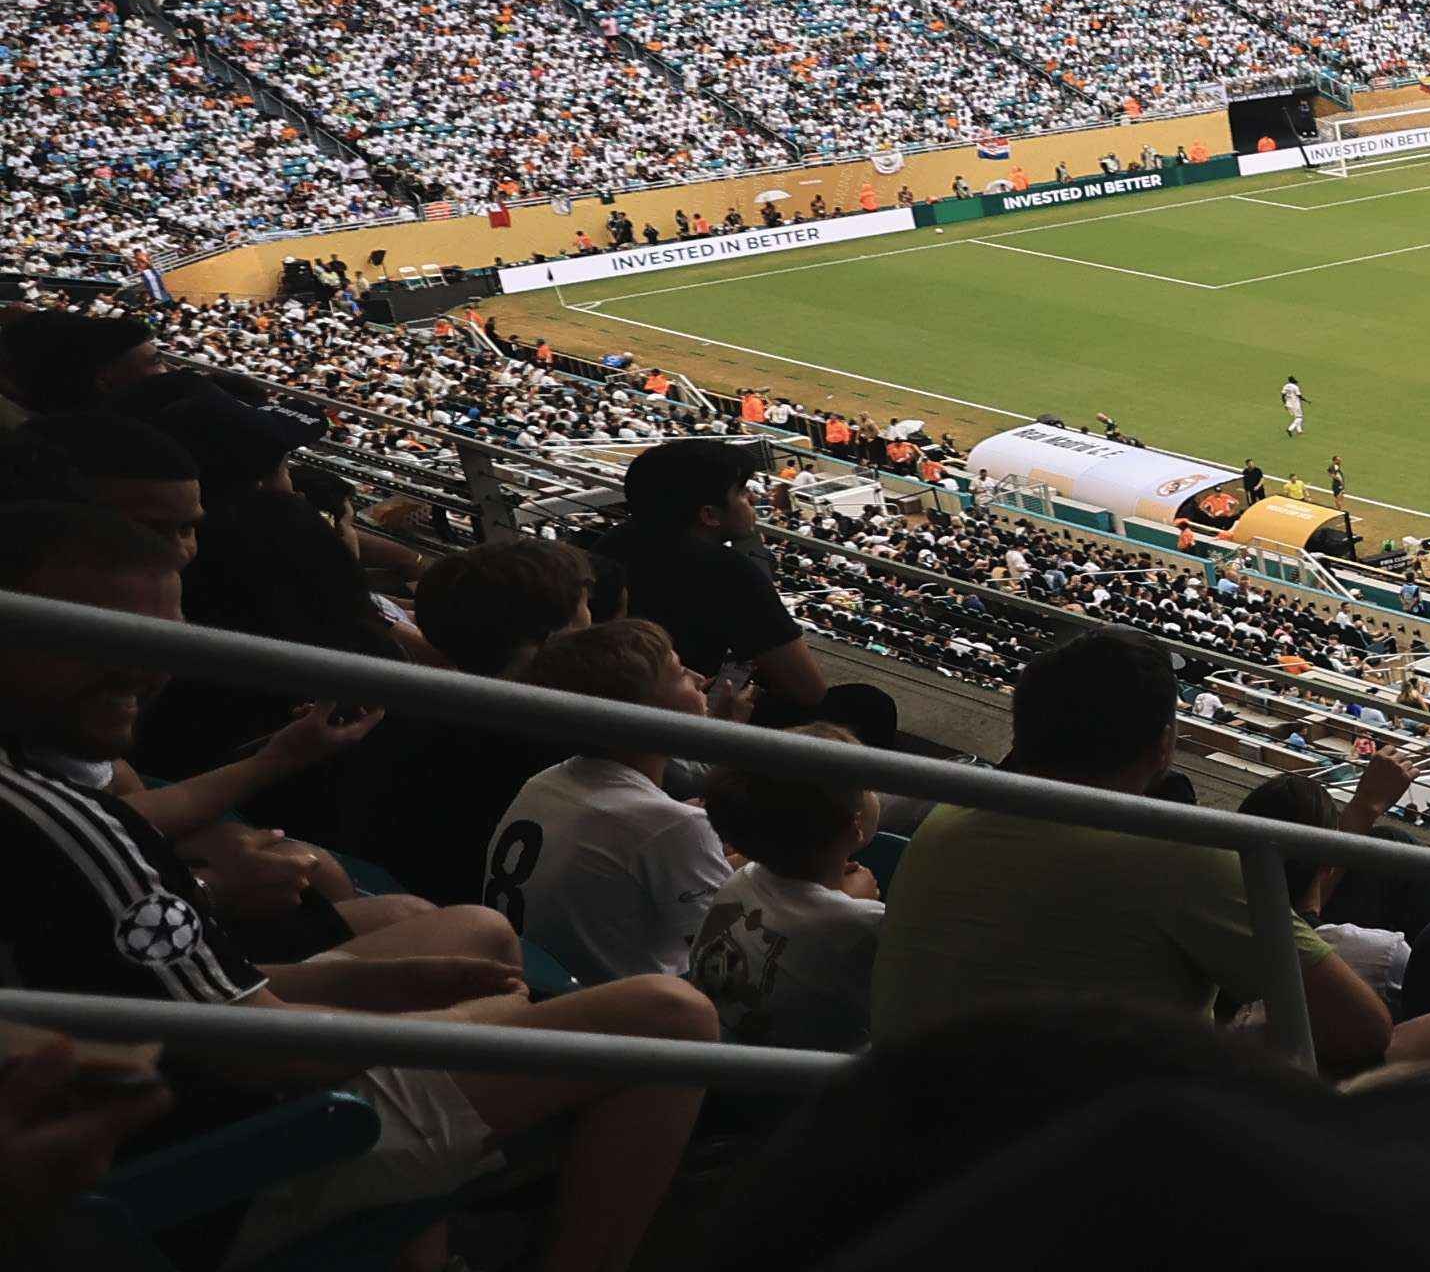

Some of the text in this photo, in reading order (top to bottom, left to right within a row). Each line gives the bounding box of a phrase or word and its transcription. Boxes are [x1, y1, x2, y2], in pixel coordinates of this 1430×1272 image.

[1310, 137, 1377, 160] INVESTED
[1381, 136, 1395, 149] IN
[1003, 174, 1162, 211] INVESTED IN BETTER
[611, 226, 821, 272] INVESTED IN BETTER
[485, 819, 543, 936] 8
